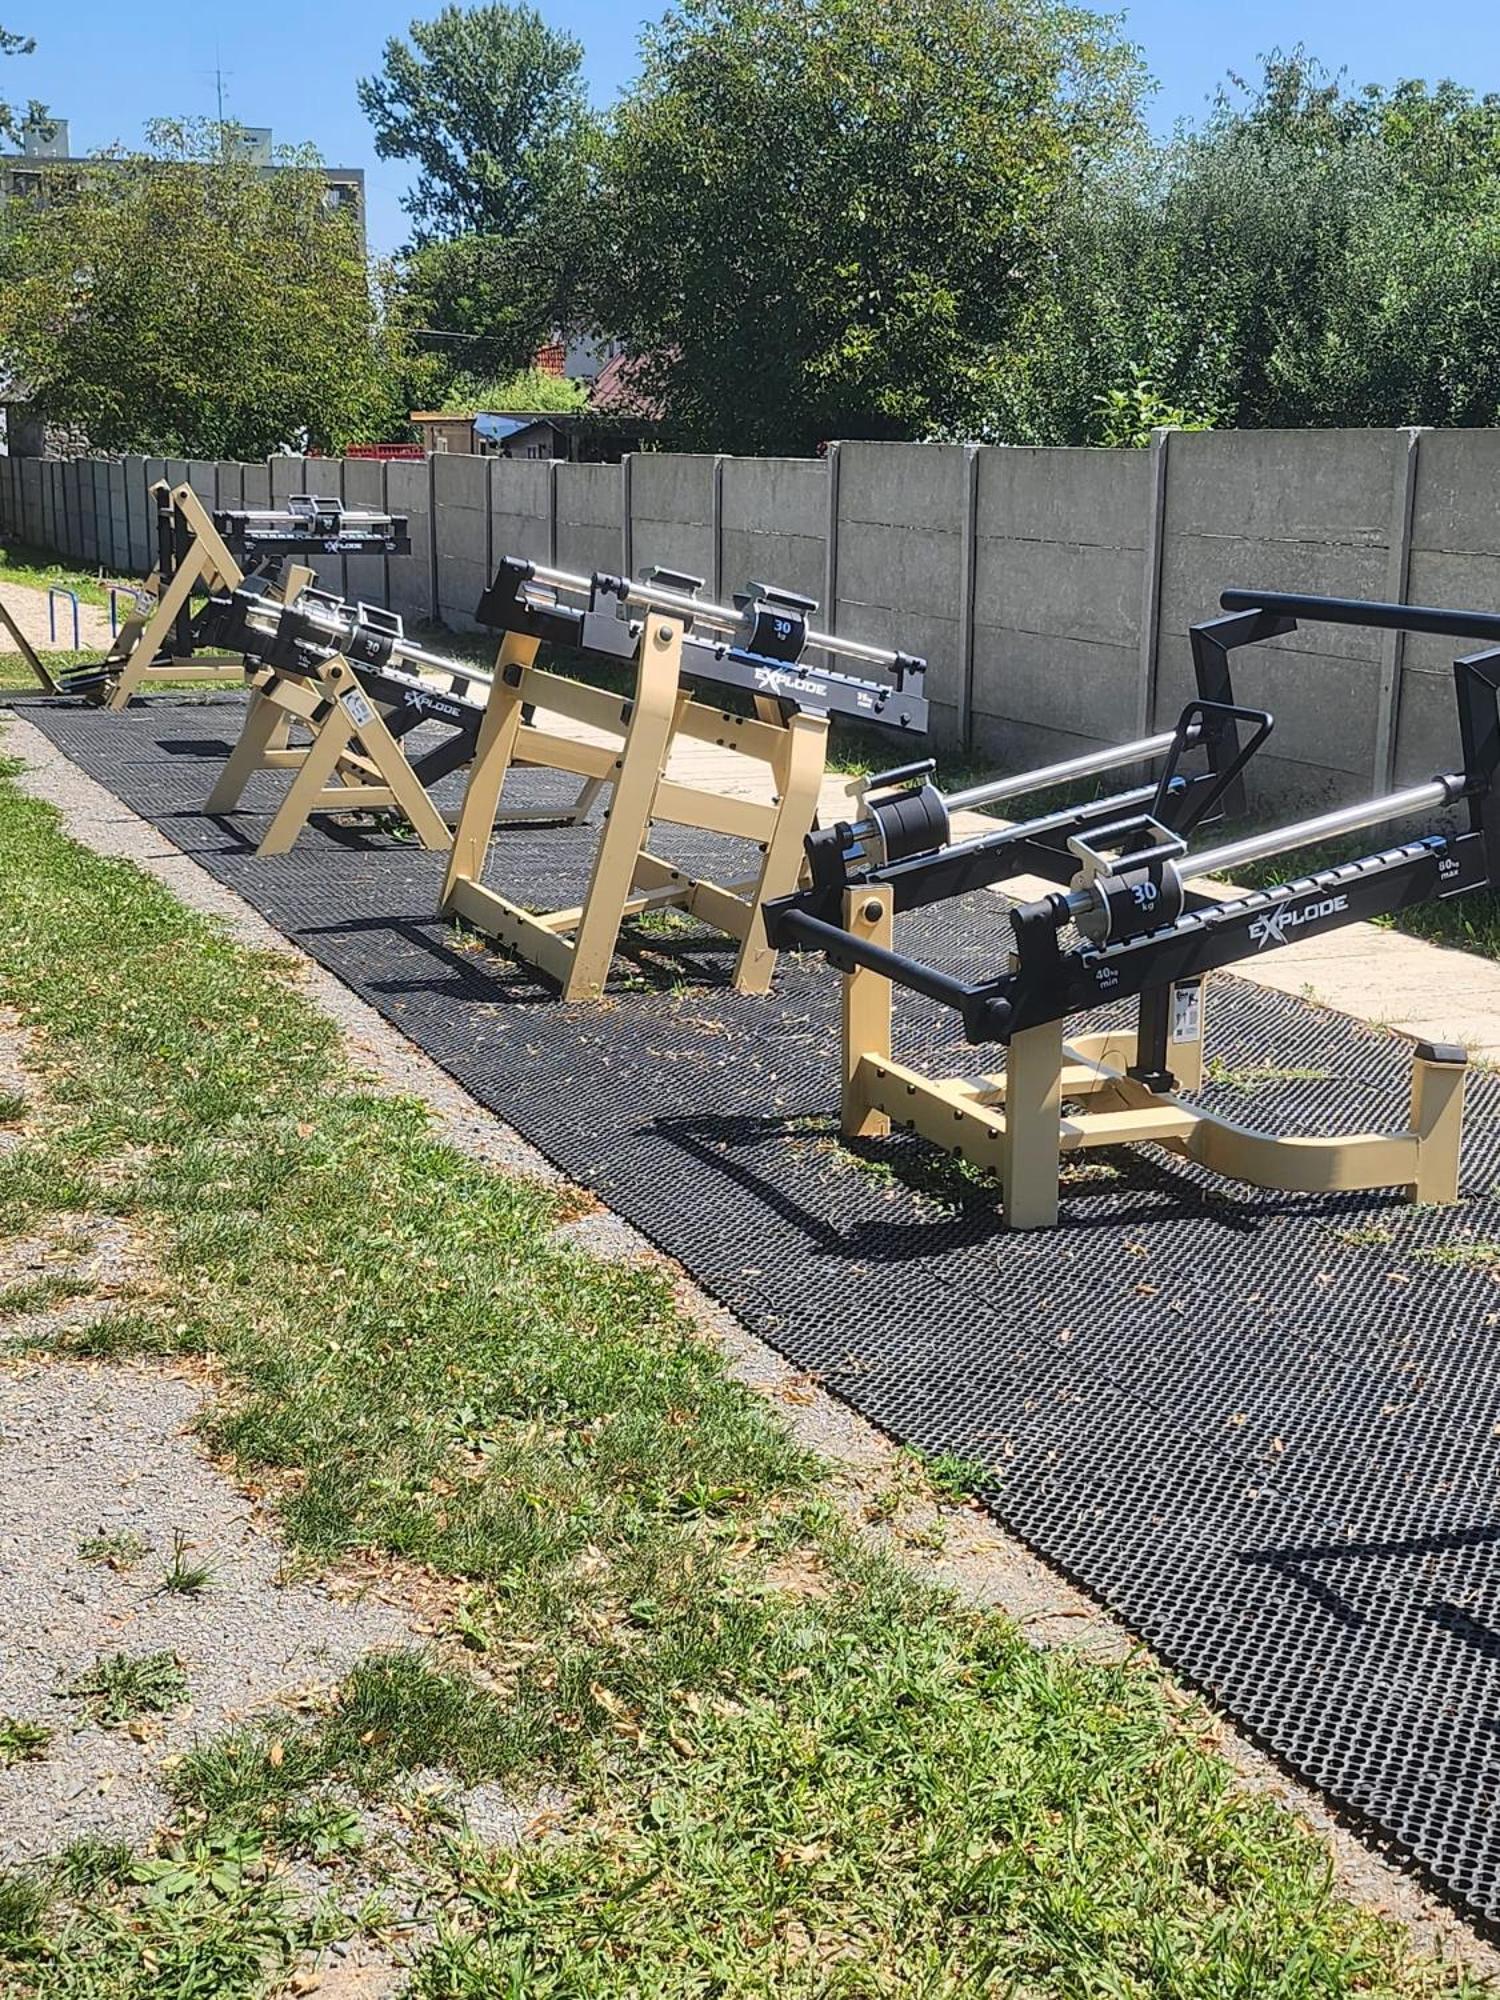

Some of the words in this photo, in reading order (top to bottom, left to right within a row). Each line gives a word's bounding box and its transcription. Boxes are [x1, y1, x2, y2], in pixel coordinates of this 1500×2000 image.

[774, 619, 792, 634] 30
[366, 639, 380, 653] 30
[755, 666, 827, 696] EXPLODE
[404, 690, 461, 717] EXPLODE
[1132, 882, 1157, 904] 30
[1142, 902, 1155, 912] kg
[1248, 894, 1349, 950] EXPLODE
[1100, 978, 1118, 989] min
